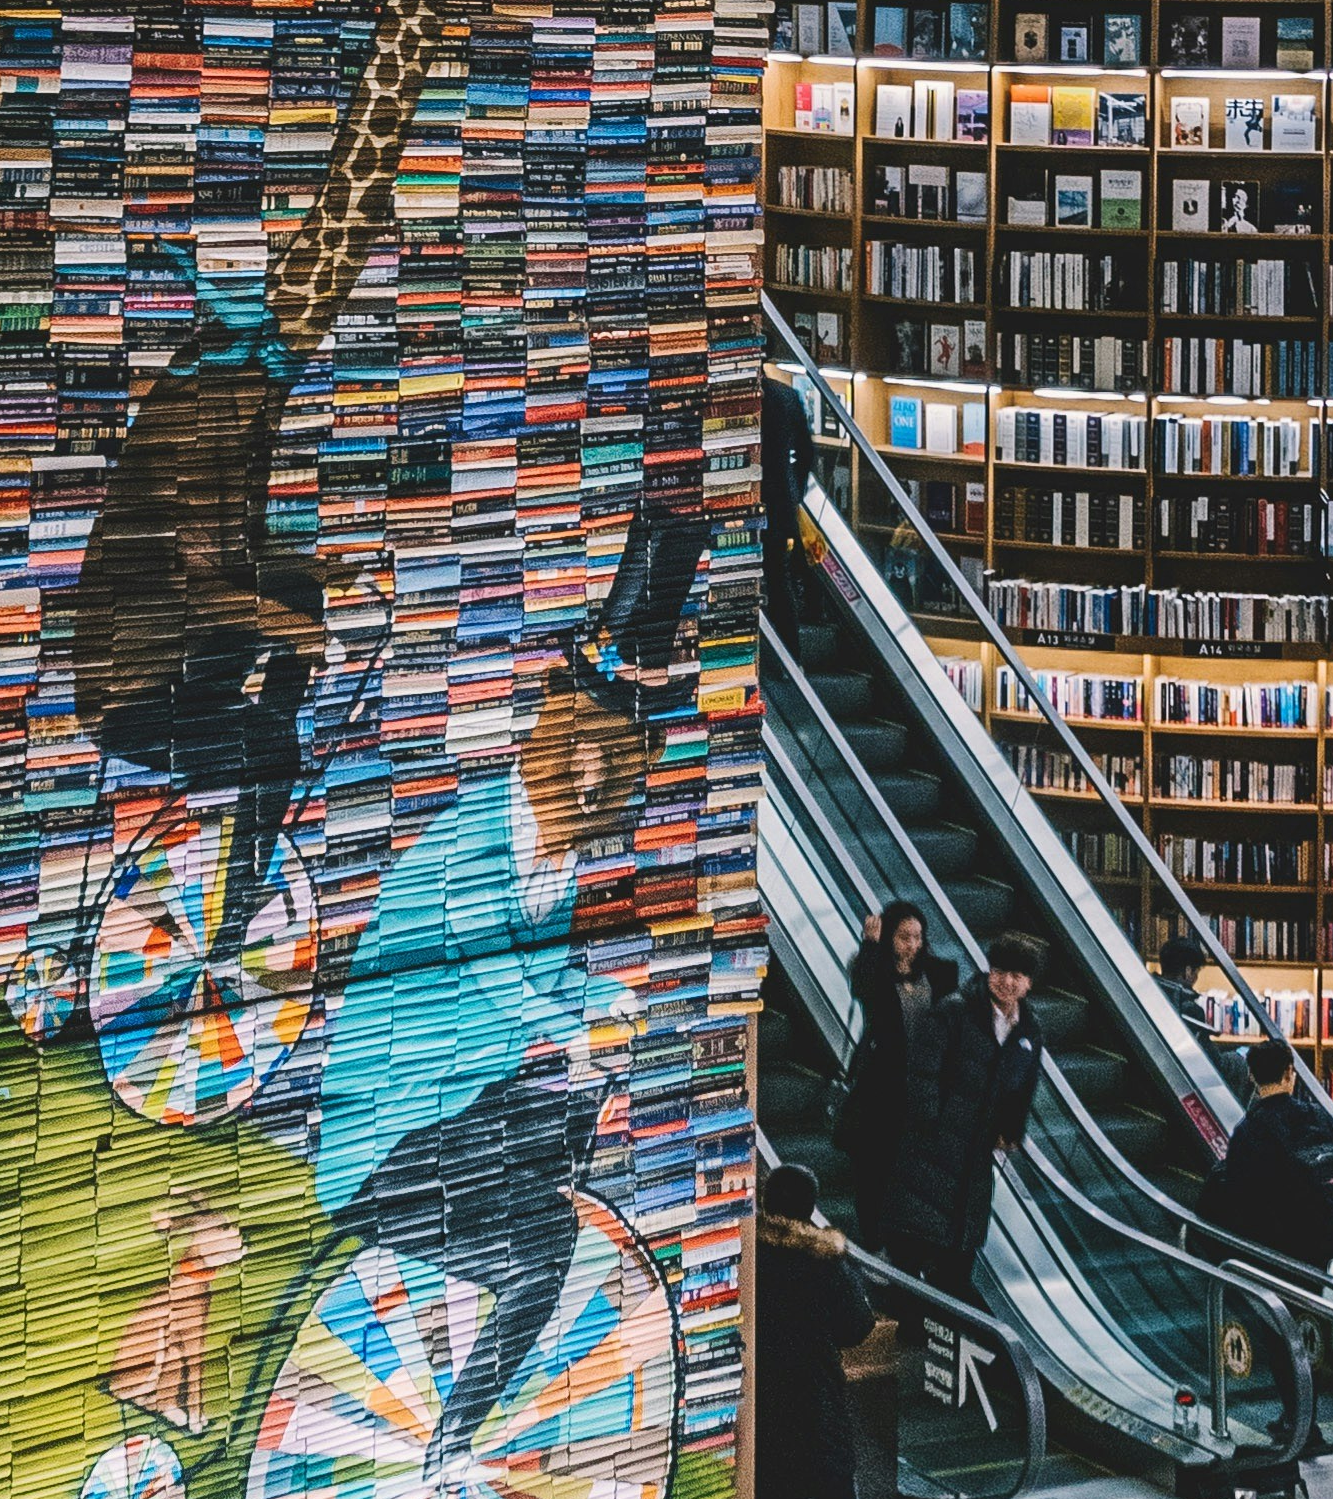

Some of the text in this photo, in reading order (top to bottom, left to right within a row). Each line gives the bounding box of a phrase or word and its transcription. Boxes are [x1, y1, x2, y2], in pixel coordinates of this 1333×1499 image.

[894, 416, 914, 428] ONE
[1037, 633, 1058, 646] A13
[1199, 643, 1222, 656] A14
